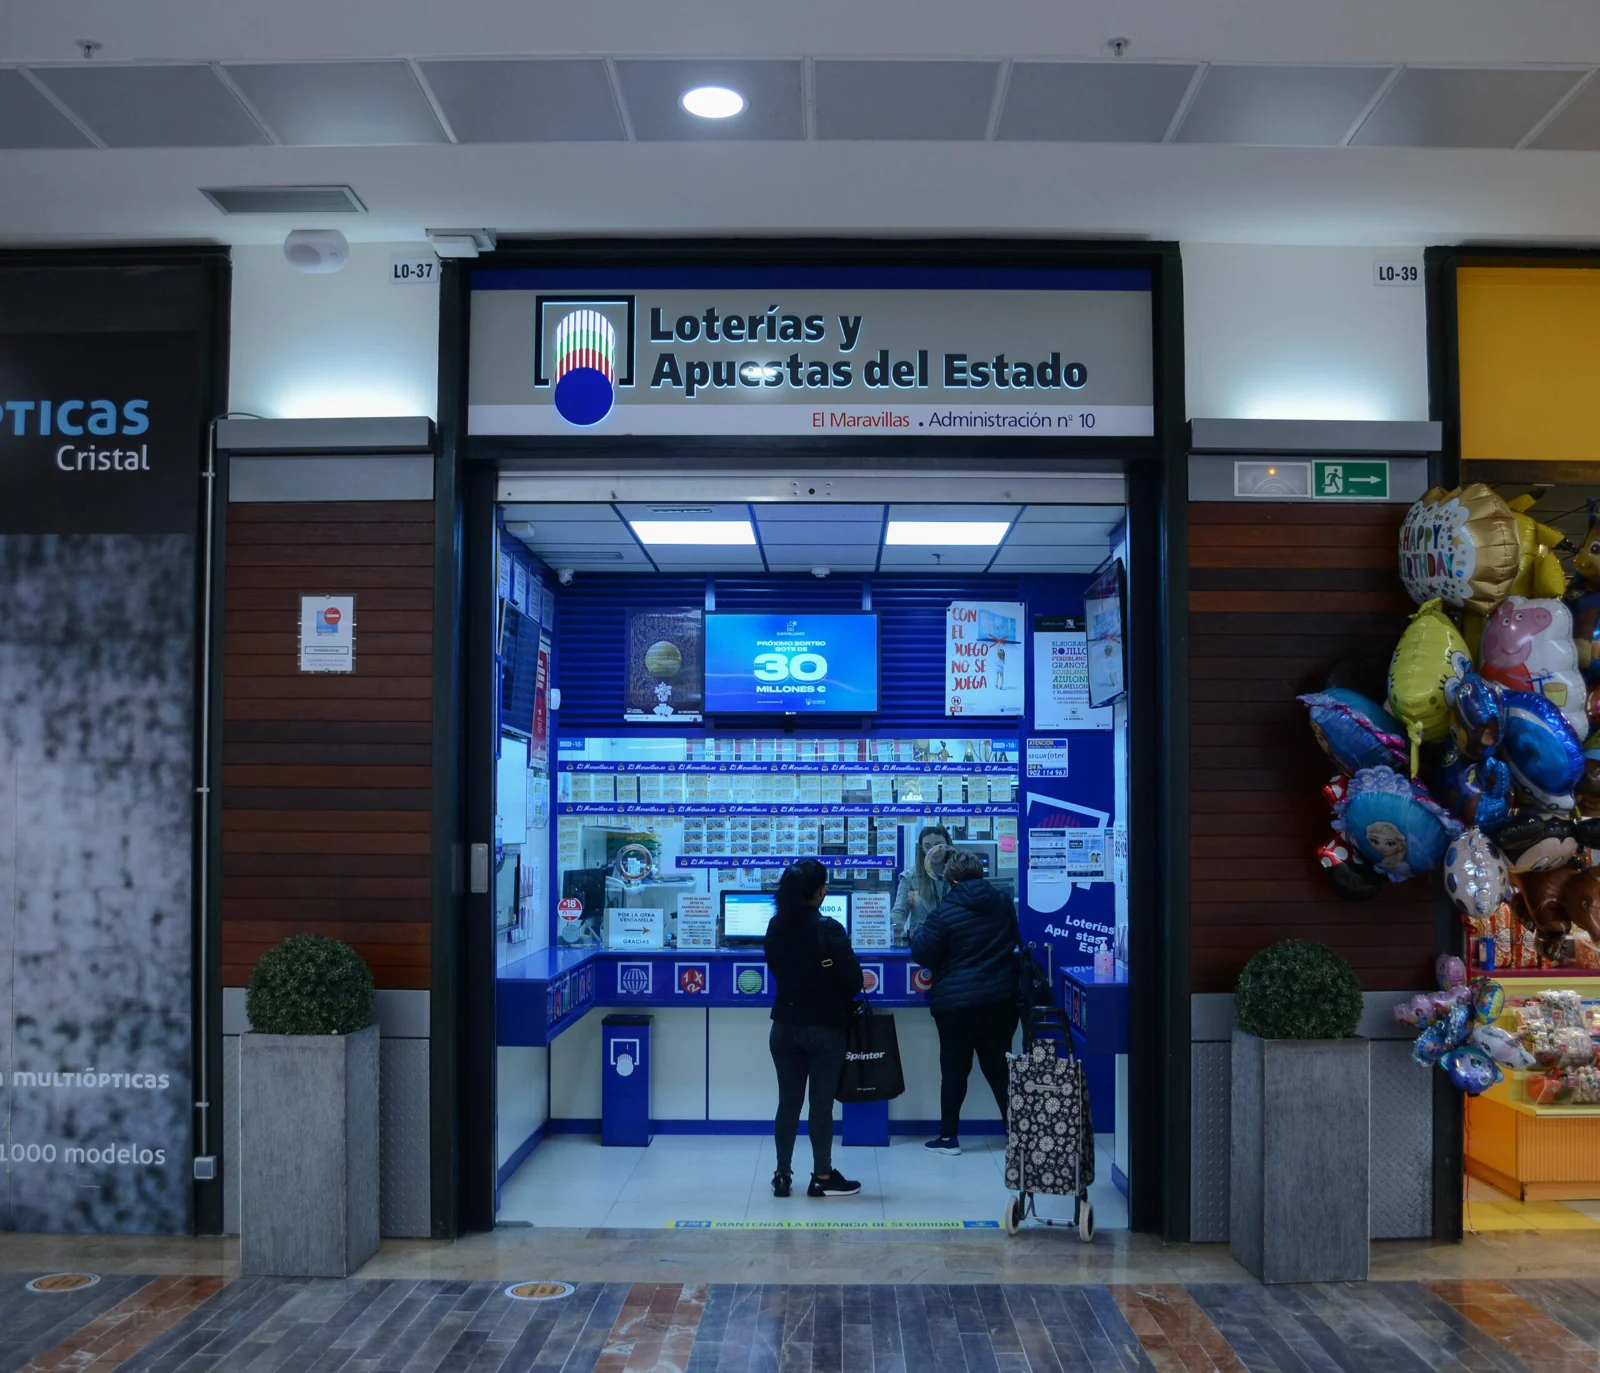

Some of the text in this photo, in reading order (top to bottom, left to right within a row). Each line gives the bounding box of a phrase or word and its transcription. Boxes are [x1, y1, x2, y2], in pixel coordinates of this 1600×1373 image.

[393, 263, 433, 279] LO-37
[1379, 266, 1418, 281] LO-39
[649, 304, 863, 352] Loterías y
[650, 350, 1089, 399] Apuestas del Estado
[812, 411, 827, 429] El
[830, 411, 911, 429] Maravillas
[928, 410, 1052, 429] Administración
[1078, 412, 1097, 429] 10
[56, 445, 150, 471] Cristal
[1403, 524, 1442, 552] HAPPY
[952, 607, 977, 622] CON
[952, 624, 965, 639] EL
[953, 642, 989, 657] JUEGO
[754, 653, 828, 683] 30
[951, 658, 987, 674] NO SE
[756, 685, 826, 693] MILLONES €
[951, 675, 988, 691] JUEGA
[1065, 915, 1115, 935] Loterías
[845, 1051, 885, 1061] Sprinter
[64, 1143, 166, 1165] modelos
